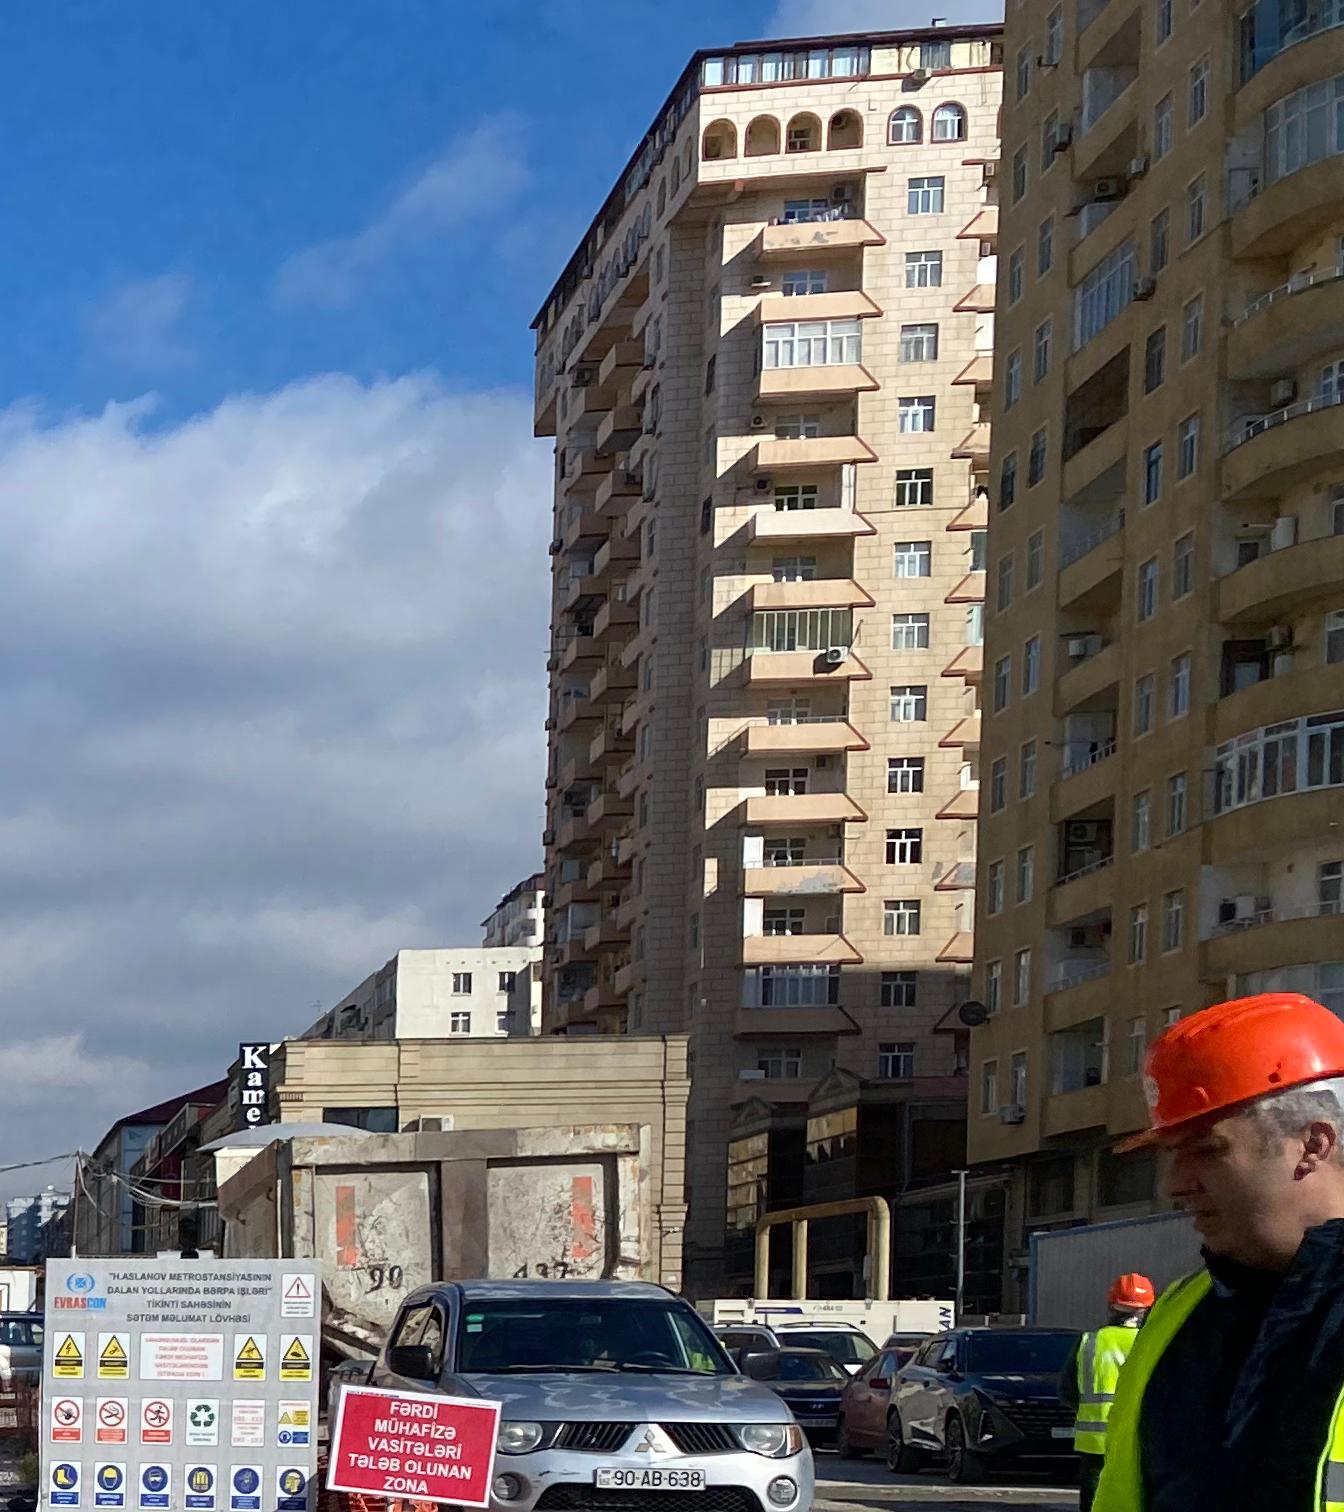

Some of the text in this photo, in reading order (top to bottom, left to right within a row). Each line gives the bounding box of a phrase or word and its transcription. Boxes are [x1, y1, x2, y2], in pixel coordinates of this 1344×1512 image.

[107, 1286, 139, 1295] DALAN
[141, 1286, 201, 1295] YOLLARINDA
[203, 1286, 235, 1296] BƏRPA
[54, 1296, 107, 1309] EVRASCON
[126, 1312, 251, 1324] SƏTƏM MƏLUMAT LÖVHƏSİ
[390, 1401, 439, 1419] FƏRDİ
[374, 1417, 457, 1440] MÜHAFİZƏ
[367, 1437, 463, 1460] VASİTƏLƏRİ
[348, 1453, 472, 1480] TƏLƏB OLUNAN
[383, 1476, 429, 1494] ZONA
[614, 1470, 701, 1488] 90-AB-638
